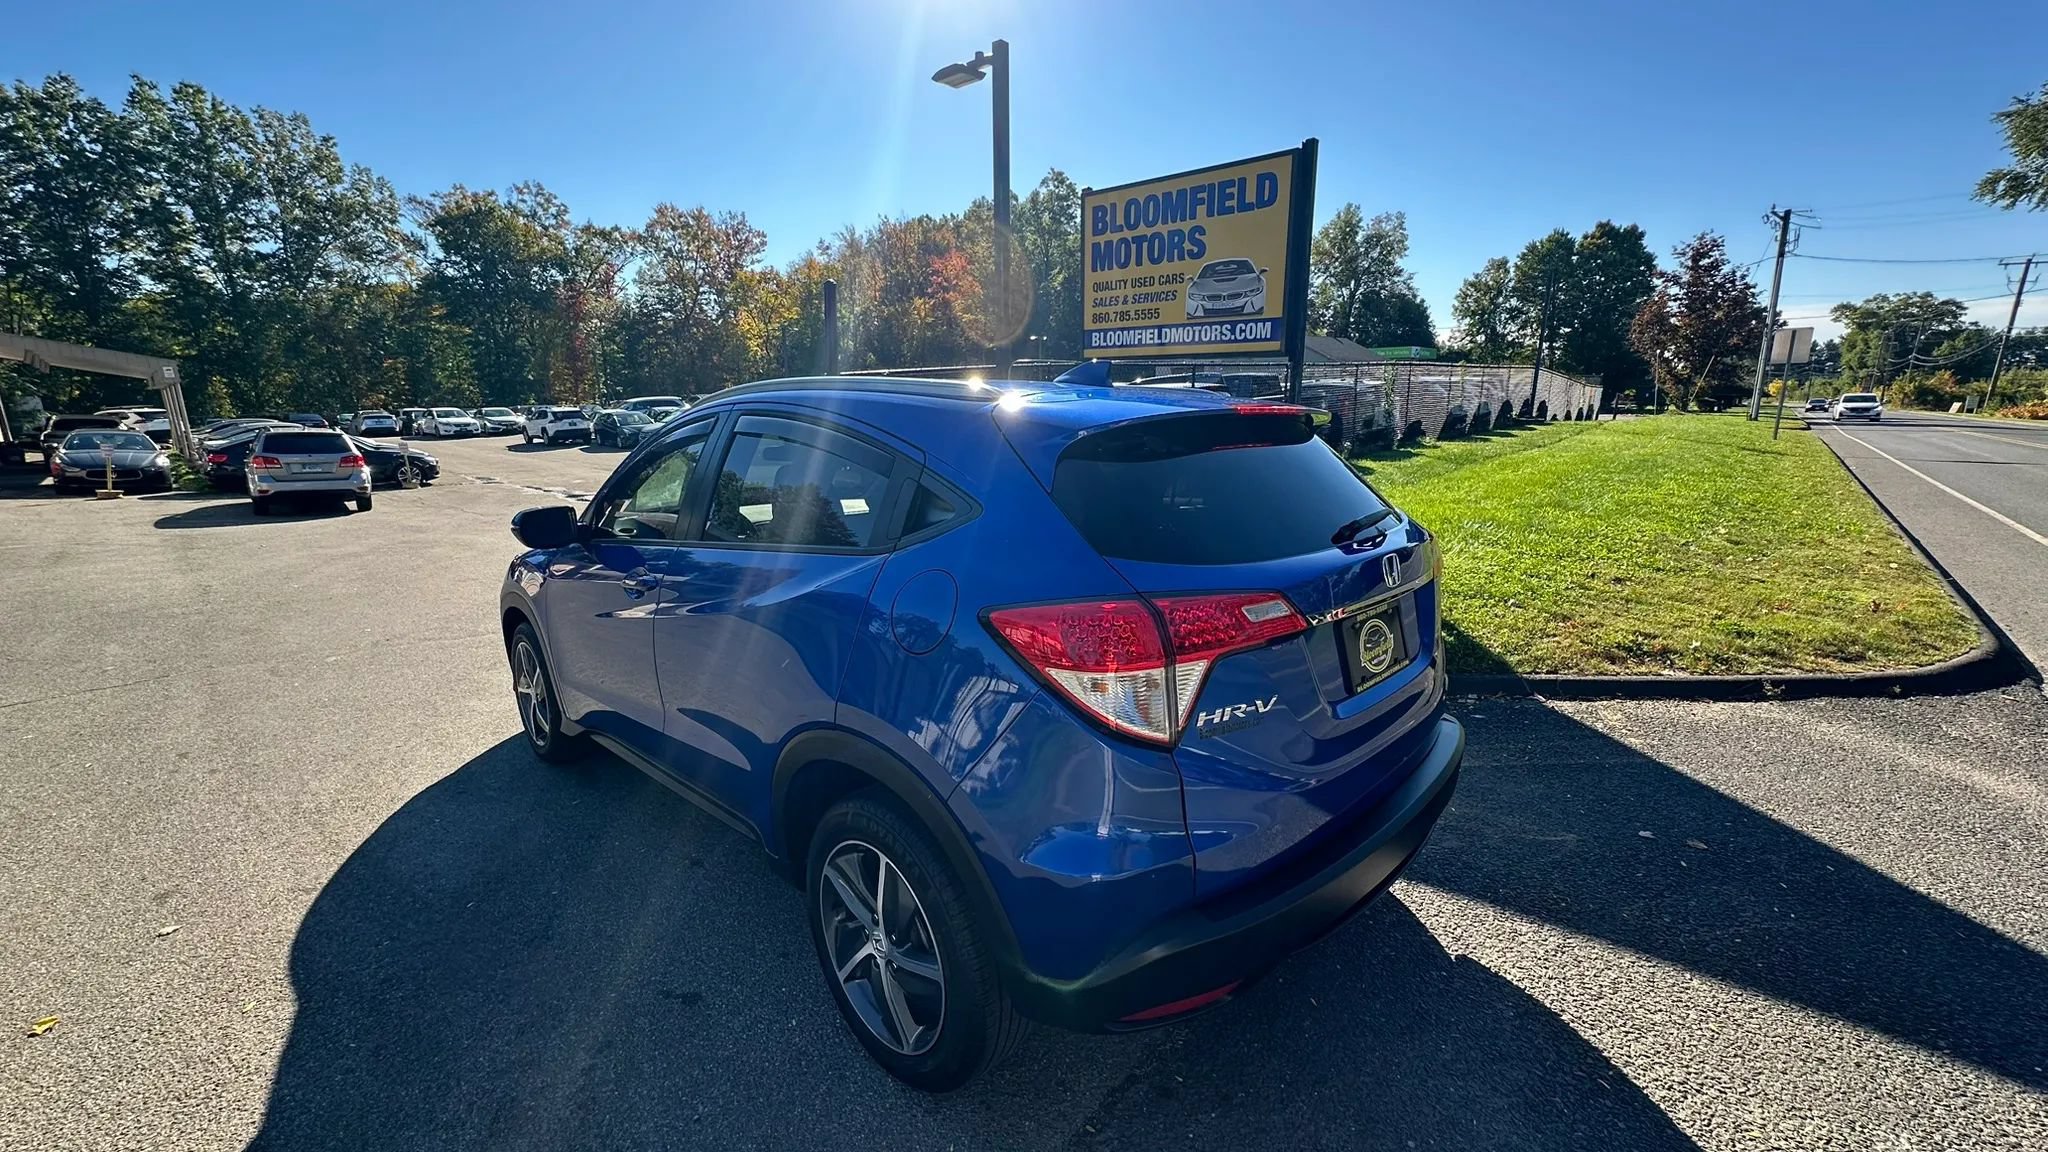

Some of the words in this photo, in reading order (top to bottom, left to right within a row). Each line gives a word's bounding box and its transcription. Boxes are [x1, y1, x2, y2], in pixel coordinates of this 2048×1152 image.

[1092, 171, 1279, 237] BLOOMFIELD
[1091, 225, 1207, 272] MOTORS
[1092, 279, 1128, 293] QUALITY
[1131, 276, 1155, 289] USED
[1158, 272, 1185, 286] CARS
[1092, 295, 1120, 308] SALES
[1121, 294, 1129, 305] &
[1131, 289, 1178, 305] SERVICES
[1092, 308, 1160, 324] 860.785.5555
[1091, 321, 1272, 347] BLOOMFIELDMOTORS.COM
[1196, 694, 1279, 727] HR-V
